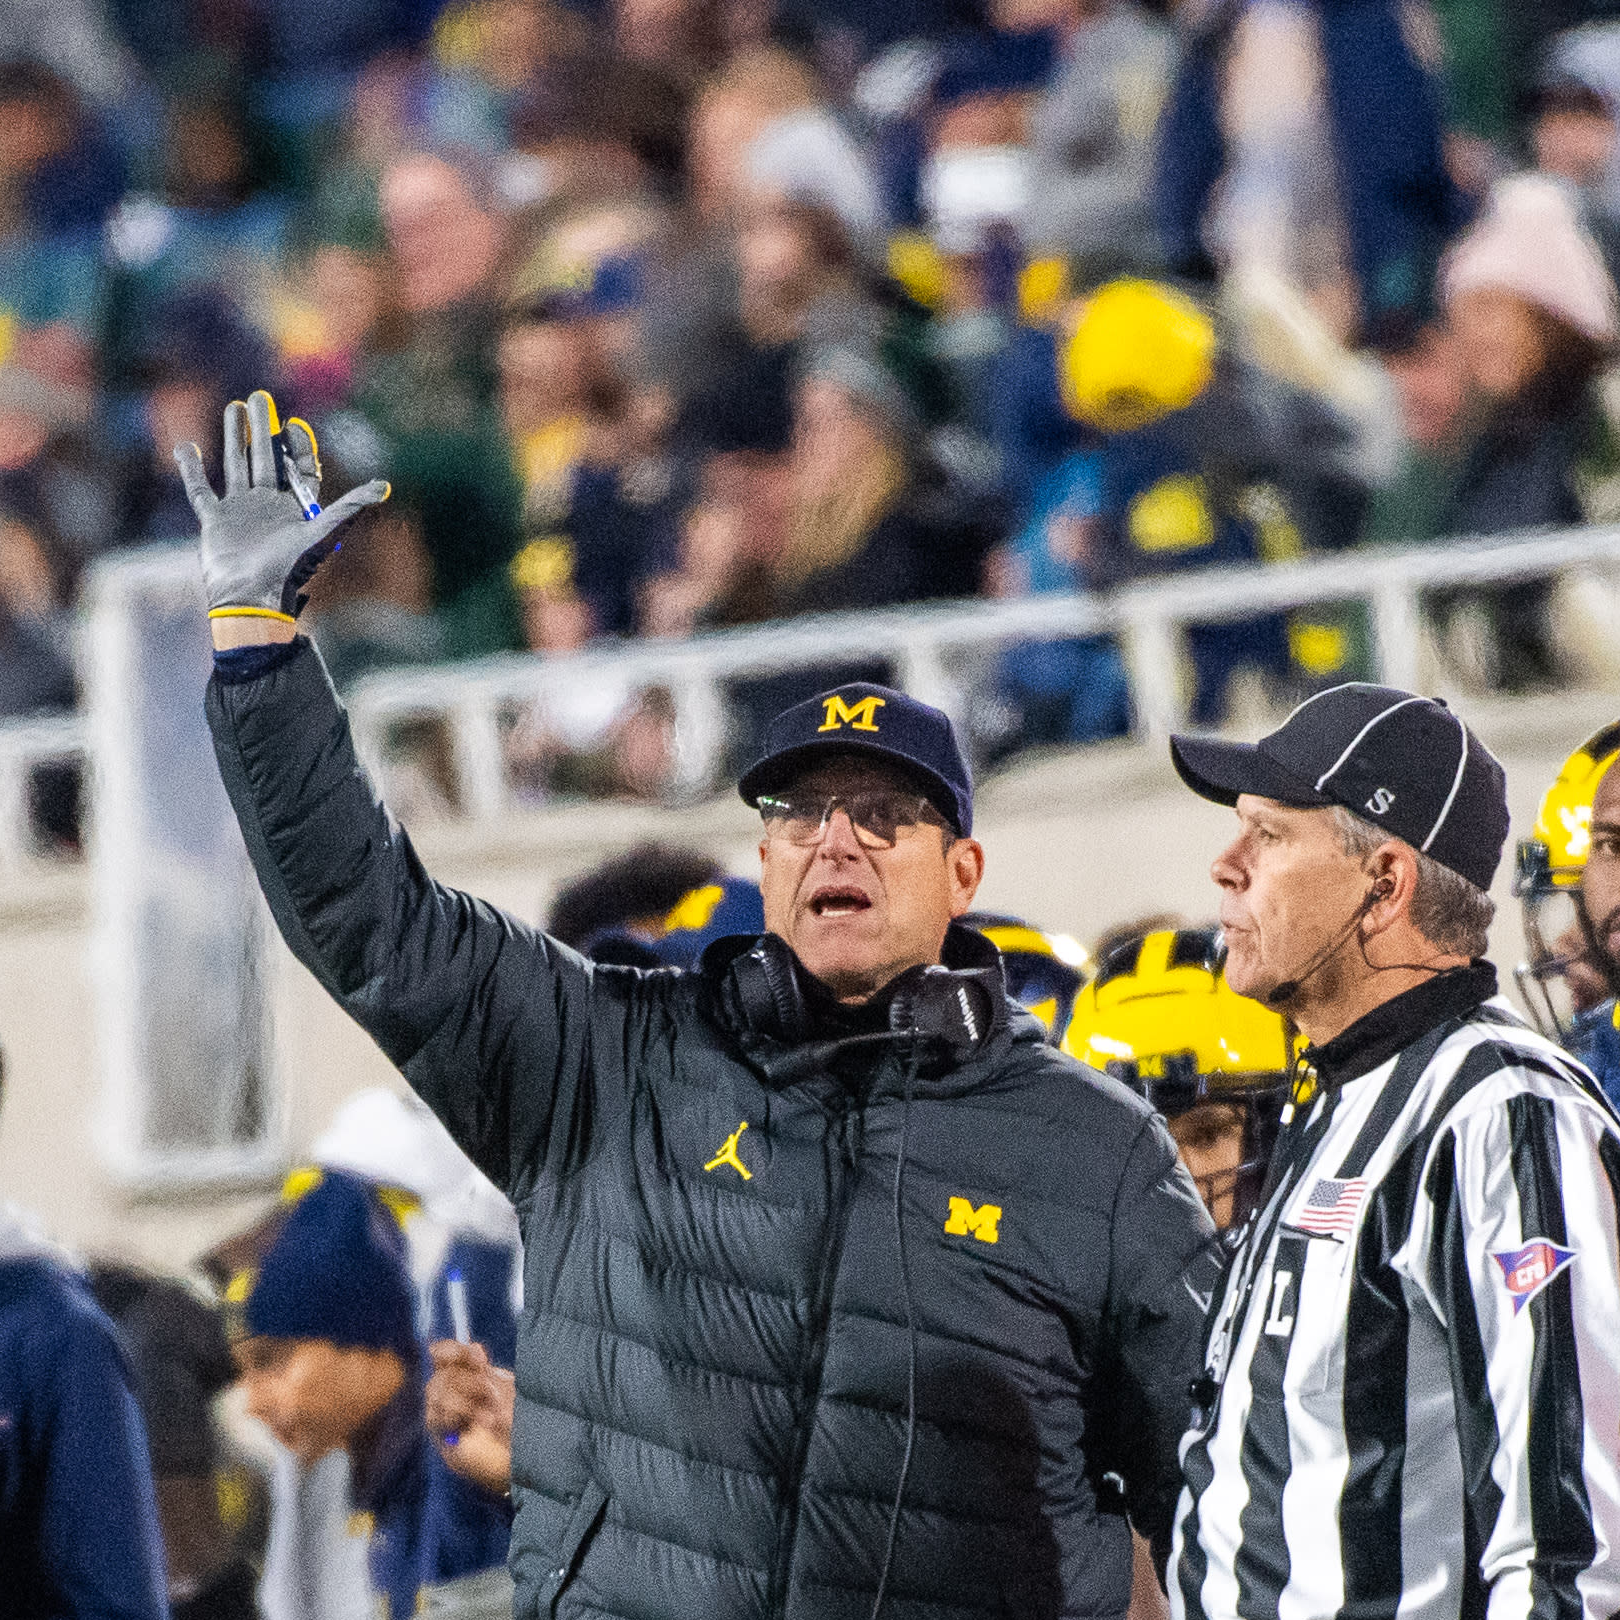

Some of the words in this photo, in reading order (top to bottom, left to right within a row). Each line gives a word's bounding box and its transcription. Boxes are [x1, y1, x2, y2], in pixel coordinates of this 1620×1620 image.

[817, 695, 886, 732] M
[1365, 787, 1396, 814] S
[944, 1195, 1002, 1245] M
[1264, 1270, 1294, 1337] L
